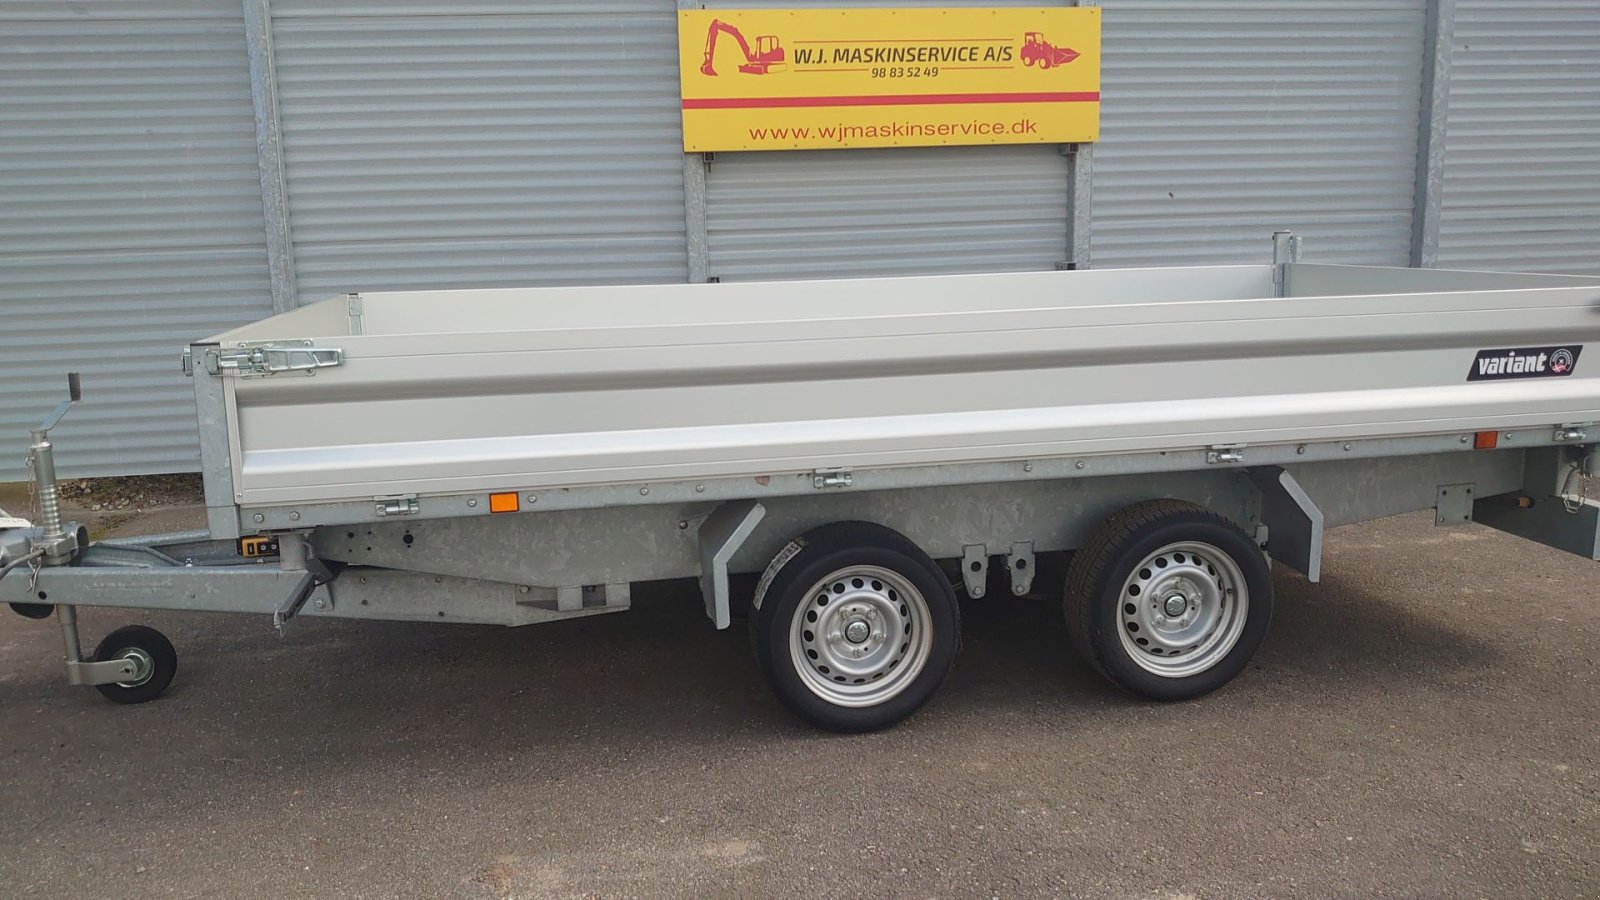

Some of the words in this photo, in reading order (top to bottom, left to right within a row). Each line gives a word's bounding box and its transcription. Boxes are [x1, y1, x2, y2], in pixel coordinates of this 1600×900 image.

[794, 48, 827, 64] W.J.
[833, 46, 979, 63] MASKINSERVICE
[983, 45, 1013, 62] A/S
[871, 67, 886, 78] 98
[889, 67, 904, 78] 83
[906, 66, 921, 77] 52
[923, 66, 939, 77] 49
[749, 119, 1038, 142] www.wjmaskinservice.dk
[1478, 351, 1548, 375] variant
